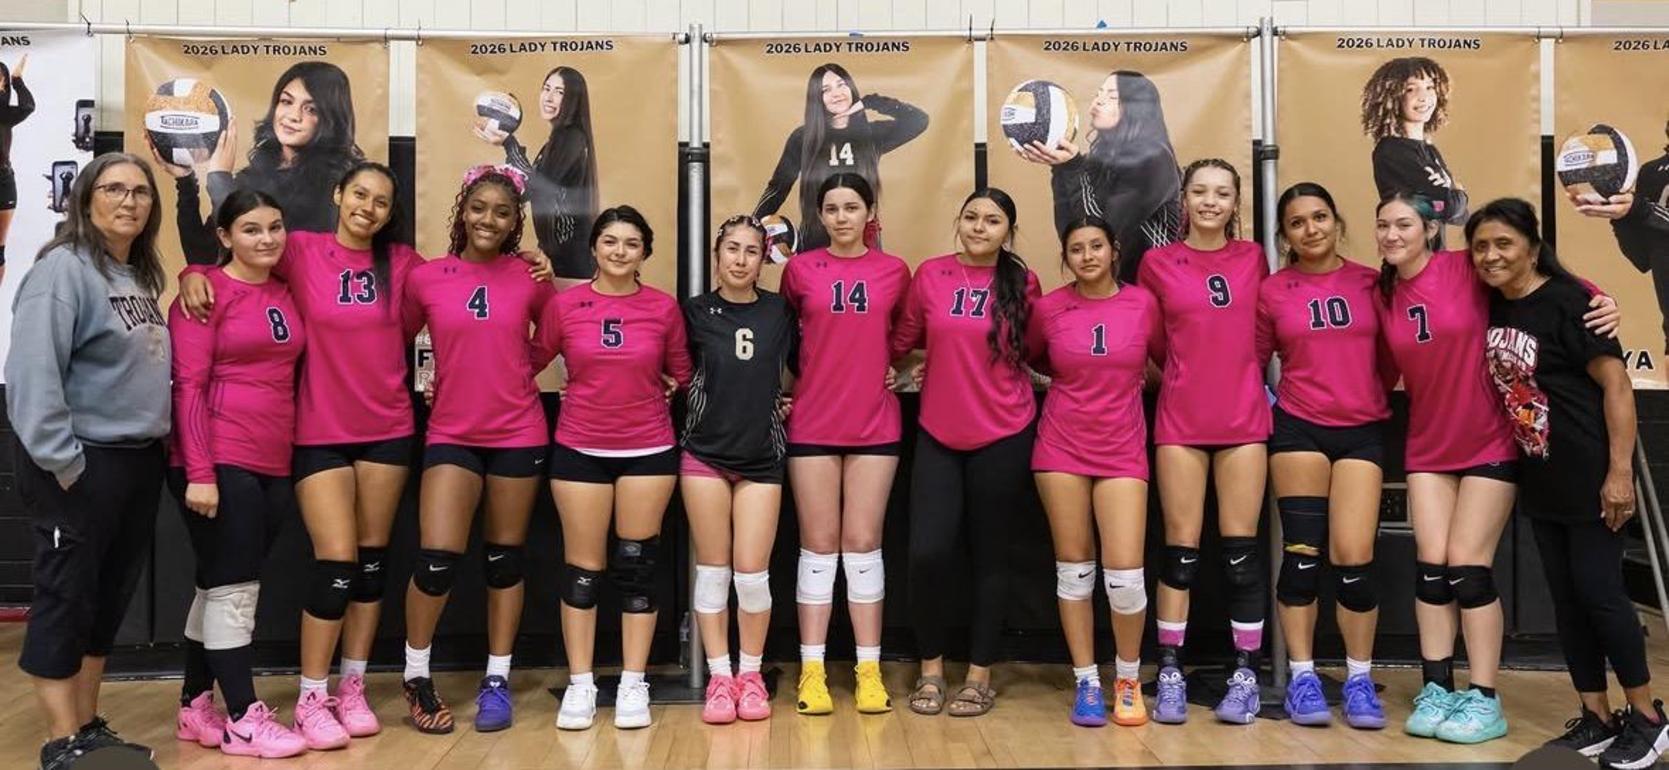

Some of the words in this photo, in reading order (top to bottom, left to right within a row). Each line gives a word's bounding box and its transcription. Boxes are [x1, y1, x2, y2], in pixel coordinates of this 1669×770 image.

[183, 44, 218, 55] 2026
[221, 44, 259, 55] LADY
[264, 44, 327, 56] TROJANS
[471, 43, 506, 54] 2026
[509, 42, 547, 53] LADY
[551, 40, 614, 51] TROJANS
[766, 43, 801, 53] 2026
[804, 42, 842, 53] LADY
[846, 41, 910, 52] TROJANS
[1043, 40, 1079, 51] 2026
[1082, 41, 1120, 52] LADY
[1124, 41, 1188, 52] TROJANS
[1337, 37, 1373, 48] 2026
[1376, 37, 1415, 48] LADY
[1418, 38, 1481, 50] TROJANS
[1614, 39, 1650, 51] 2026
[828, 142, 854, 166] 14
[338, 268, 378, 304] 13
[467, 285, 489, 319] 4
[830, 279, 869, 313] 14
[1206, 274, 1232, 308] 9
[950, 287, 989, 318] 17
[1308, 295, 1353, 330] 10
[266, 306, 291, 343] 8
[600, 317, 624, 349] 5
[1408, 303, 1433, 343] 7
[735, 327, 754, 361] 6
[1090, 323, 1108, 356] 1
